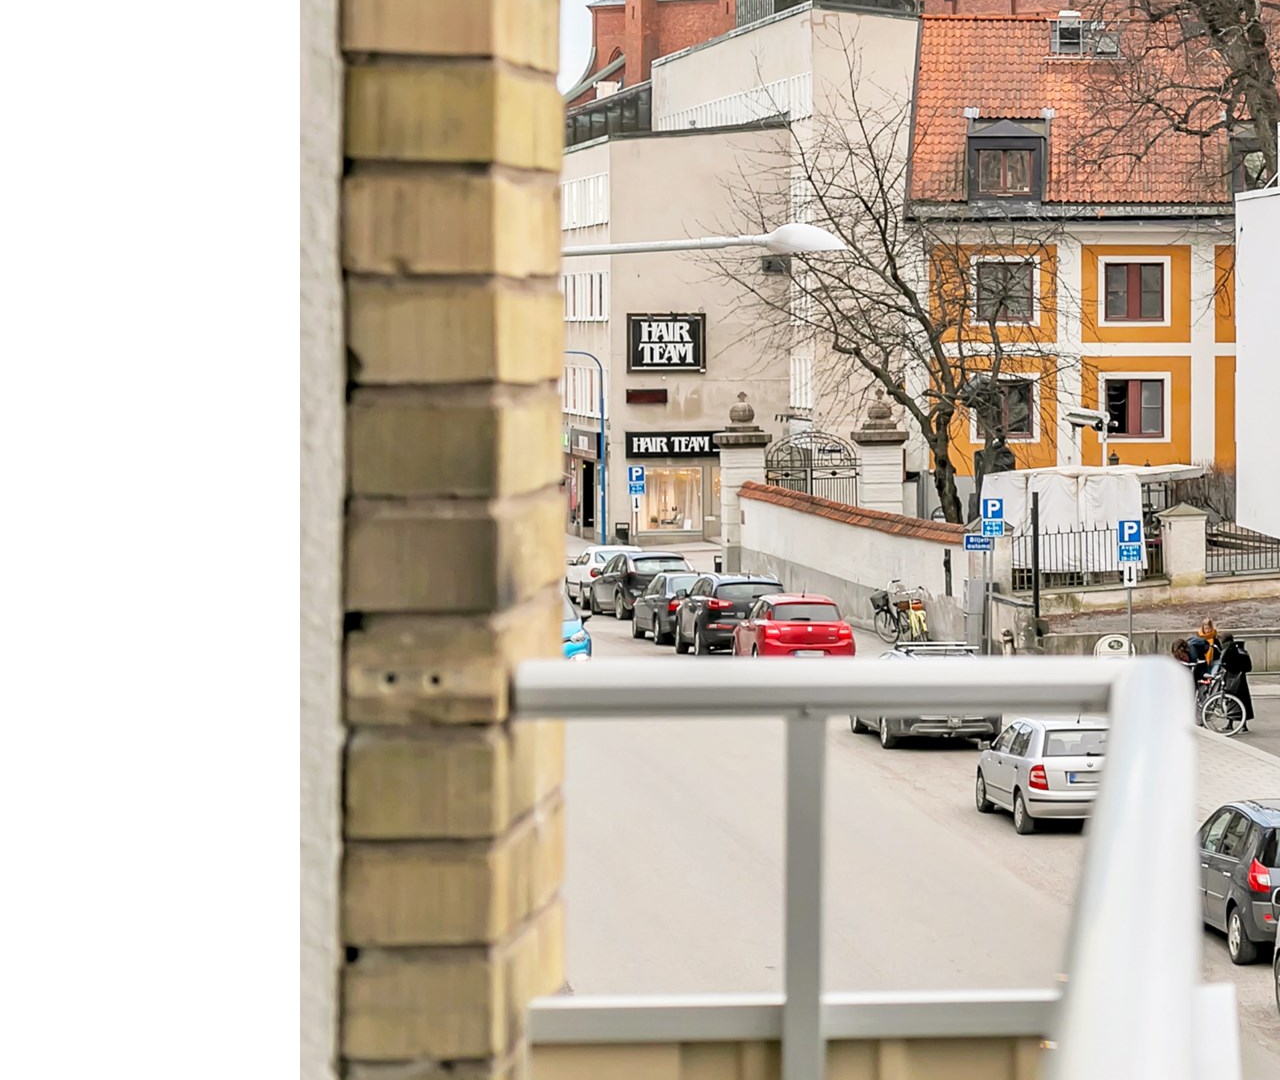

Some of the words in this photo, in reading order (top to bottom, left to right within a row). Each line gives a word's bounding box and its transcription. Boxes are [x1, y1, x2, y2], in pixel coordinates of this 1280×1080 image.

[640, 321, 692, 342] HAIR
[638, 342, 694, 364] TEAM
[632, 436, 669, 453] HAIR
[670, 436, 710, 452] TEAM
[632, 467, 642, 480] P
[987, 500, 1000, 518] P
[1124, 521, 1138, 541] P
